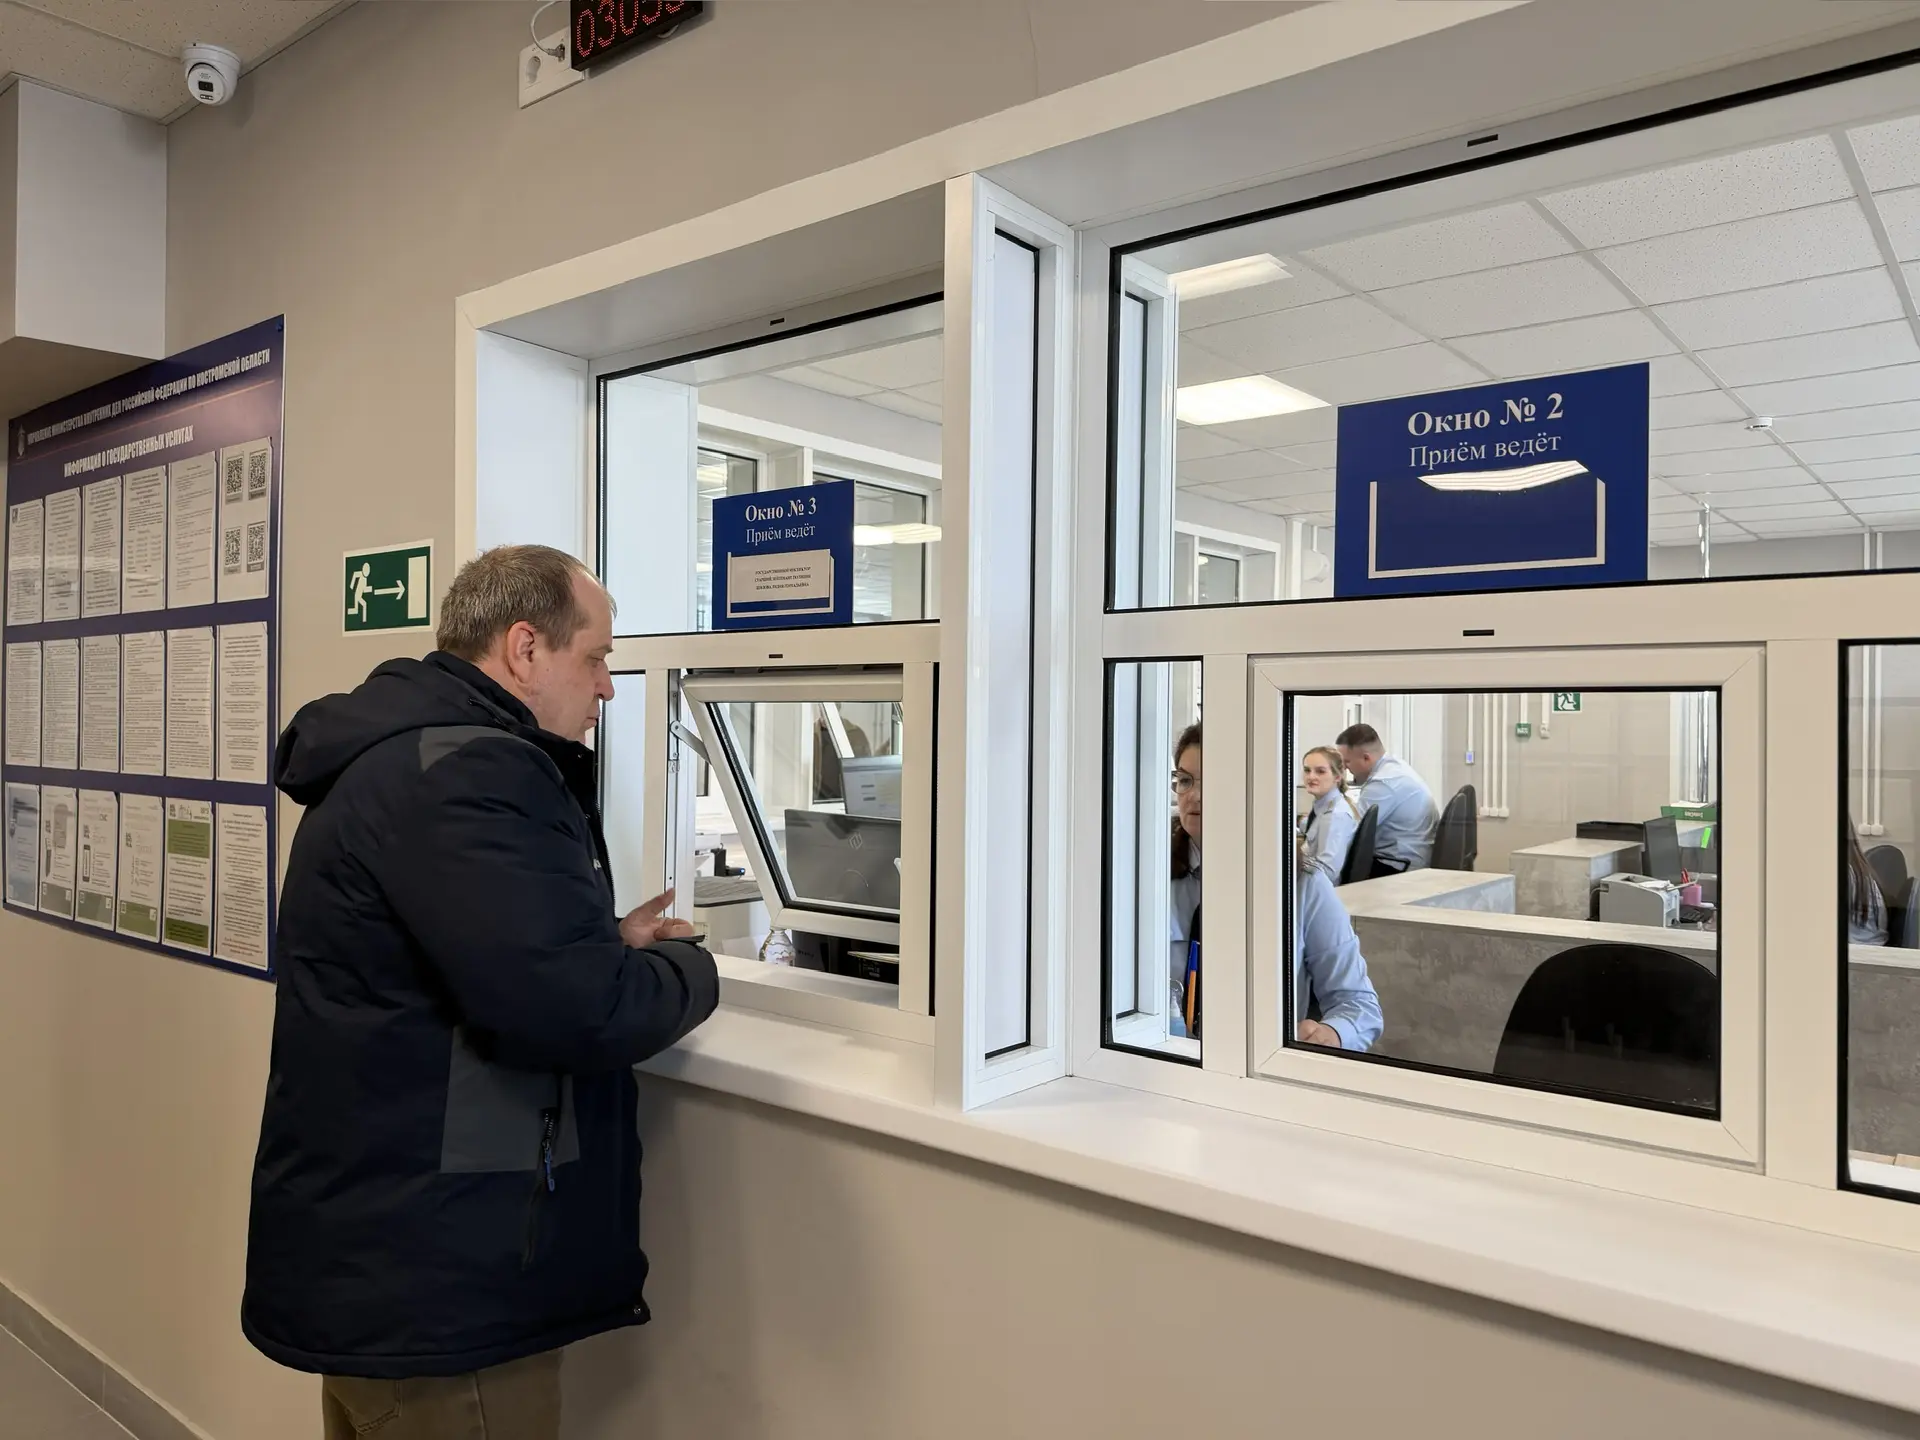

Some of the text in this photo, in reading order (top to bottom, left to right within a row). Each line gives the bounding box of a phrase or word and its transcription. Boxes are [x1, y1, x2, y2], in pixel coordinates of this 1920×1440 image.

[122, 387, 155, 412] РОССИЙСКОЙ
[155, 377, 188, 400] ФЕДЕРАЦИИ
[188, 374, 196, 390] ПО
[197, 356, 240, 387] КОСТРОМСКОЙ
[241, 348, 270, 372] ОБЛАСТИ
[1407, 393, 1564, 436] Окно № 2
[64, 425, 194, 477] ИНФОРМАЦИЯ О ГОСУДАРСТВЕННЫХ УСЛУГАХ
[1408, 432, 1562, 470] Приём ведёт
[745, 497, 817, 522] Окно № 3
[745, 522, 816, 546] Приём ведёт
